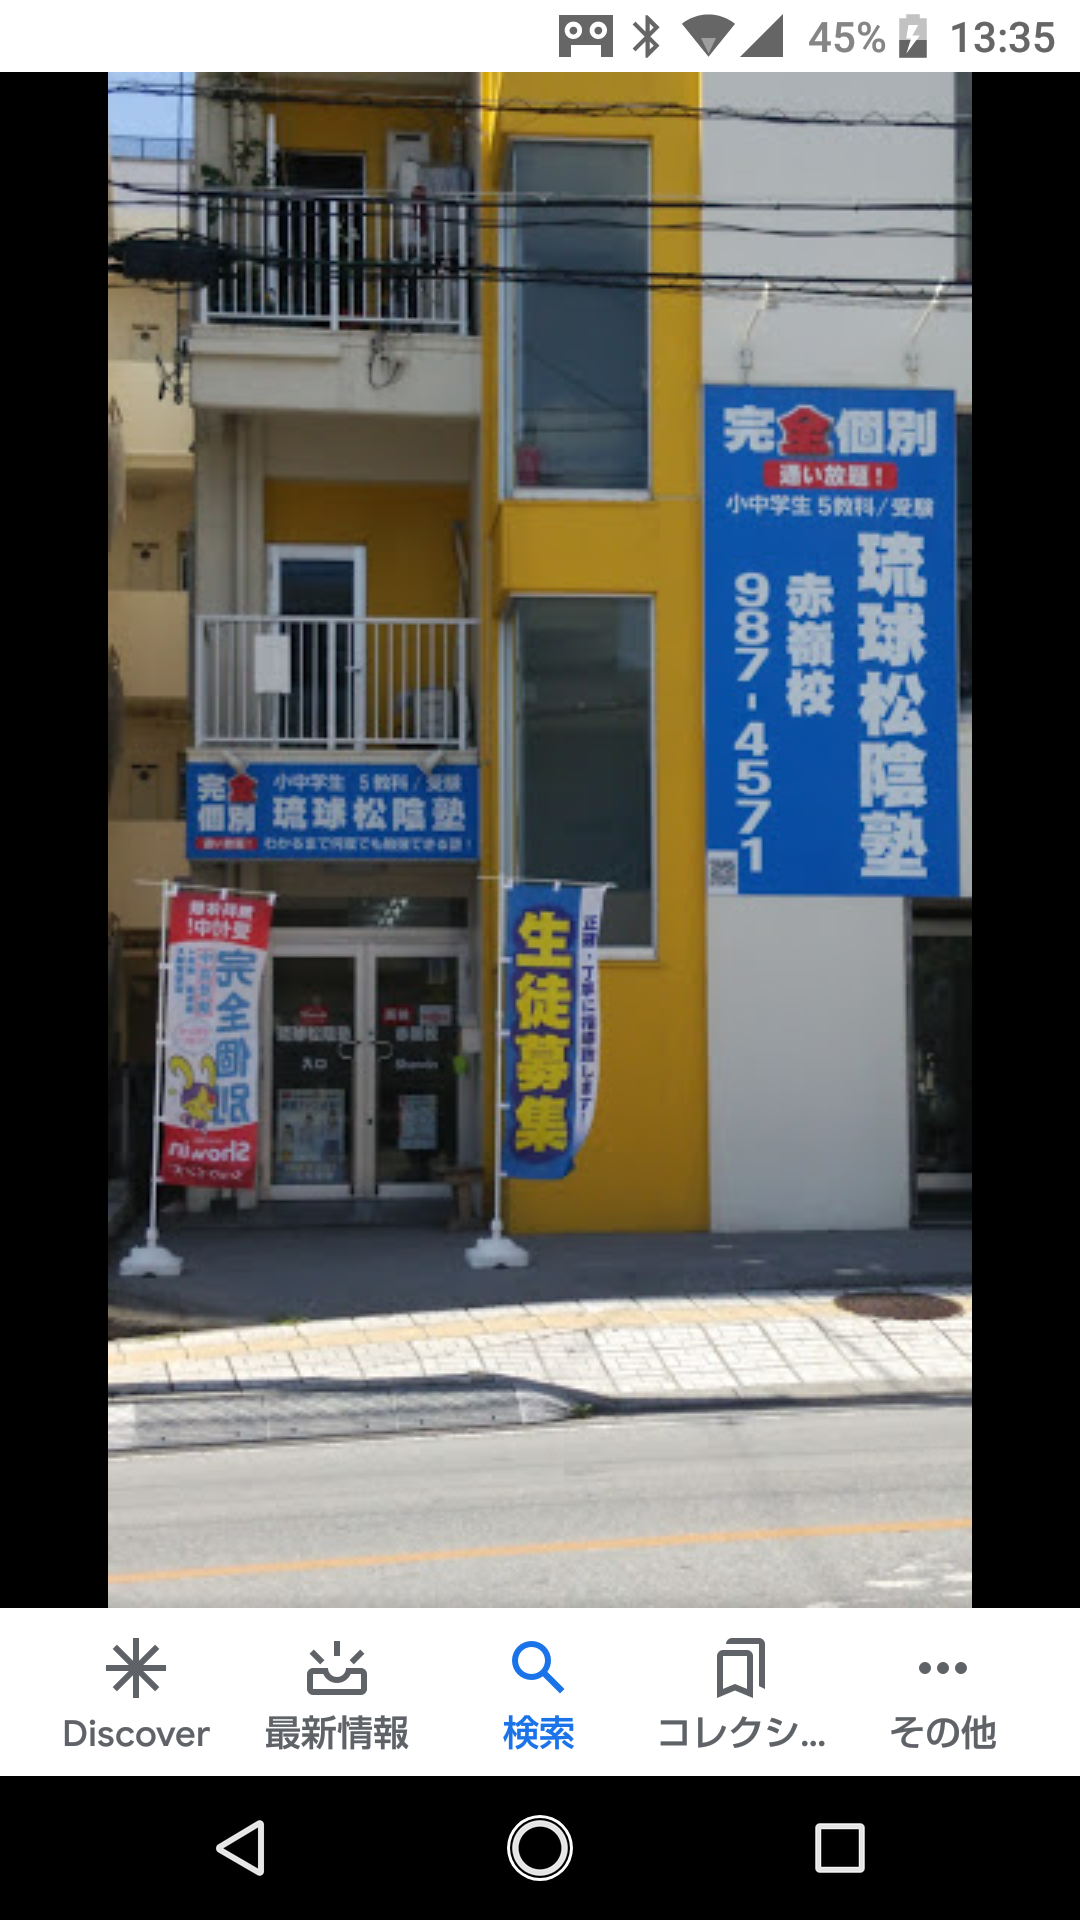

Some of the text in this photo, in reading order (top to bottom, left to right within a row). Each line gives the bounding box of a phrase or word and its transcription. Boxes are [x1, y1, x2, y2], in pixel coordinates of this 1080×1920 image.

[809, 21, 885, 53] 45%
[952, 21, 1055, 53] 13:35
[723, 405, 937, 457] 完全個別
[726, 497, 812, 517] 小中学生
[785, 571, 835, 717] 赤嶺校
[857, 531, 928, 878] 琉球松陰塾
[733, 572, 772, 873] 987-4571
[273, 773, 346, 792] 小中学生
[197, 803, 257, 833] 個別
[272, 796, 466, 832] 琉球松陰塾
[514, 910, 572, 1153] 生徒募集
[65, 1719, 210, 1747] Discover
[266, 1715, 409, 1750] 最新情報
[503, 1715, 574, 1750] 検索
[891, 1715, 996, 1750] その他
